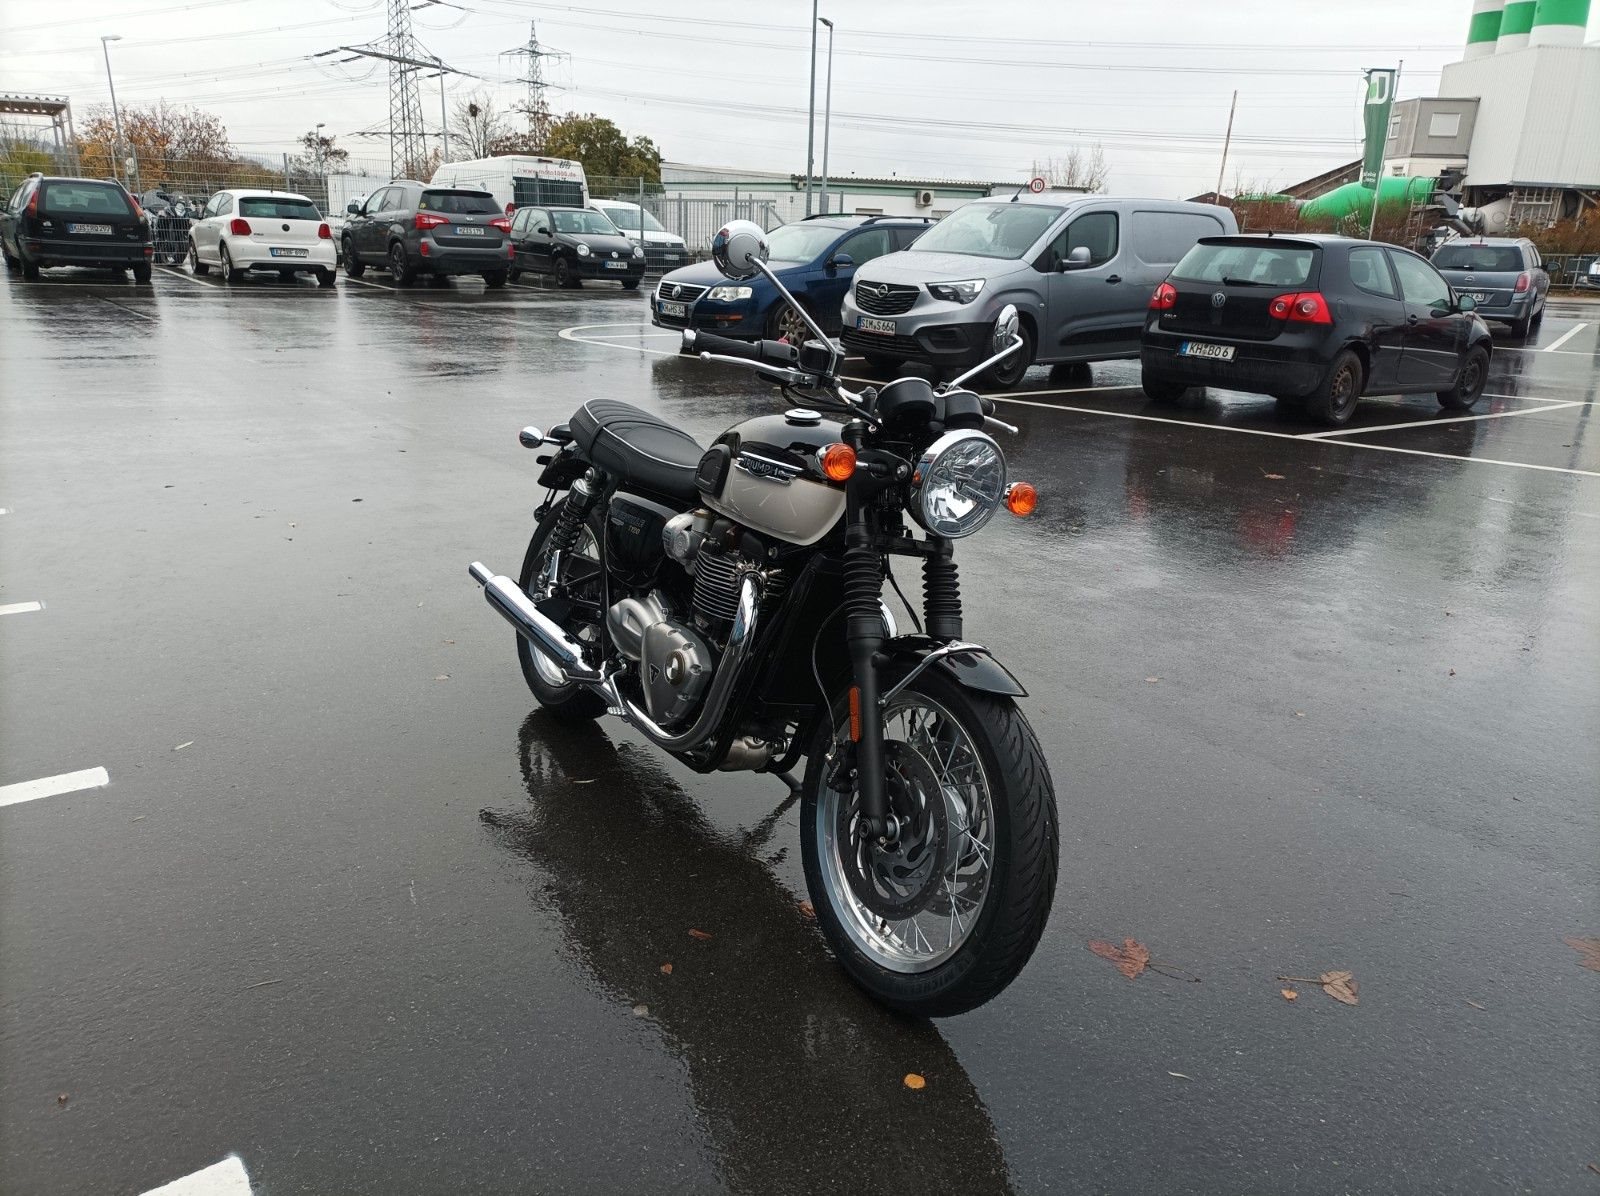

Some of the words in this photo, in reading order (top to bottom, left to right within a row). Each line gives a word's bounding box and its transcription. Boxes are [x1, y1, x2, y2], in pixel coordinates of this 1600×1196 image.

[1034, 181, 1042, 190] 10
[1189, 342, 1203, 354] KH
[743, 457, 778, 476] TRIUMPH
